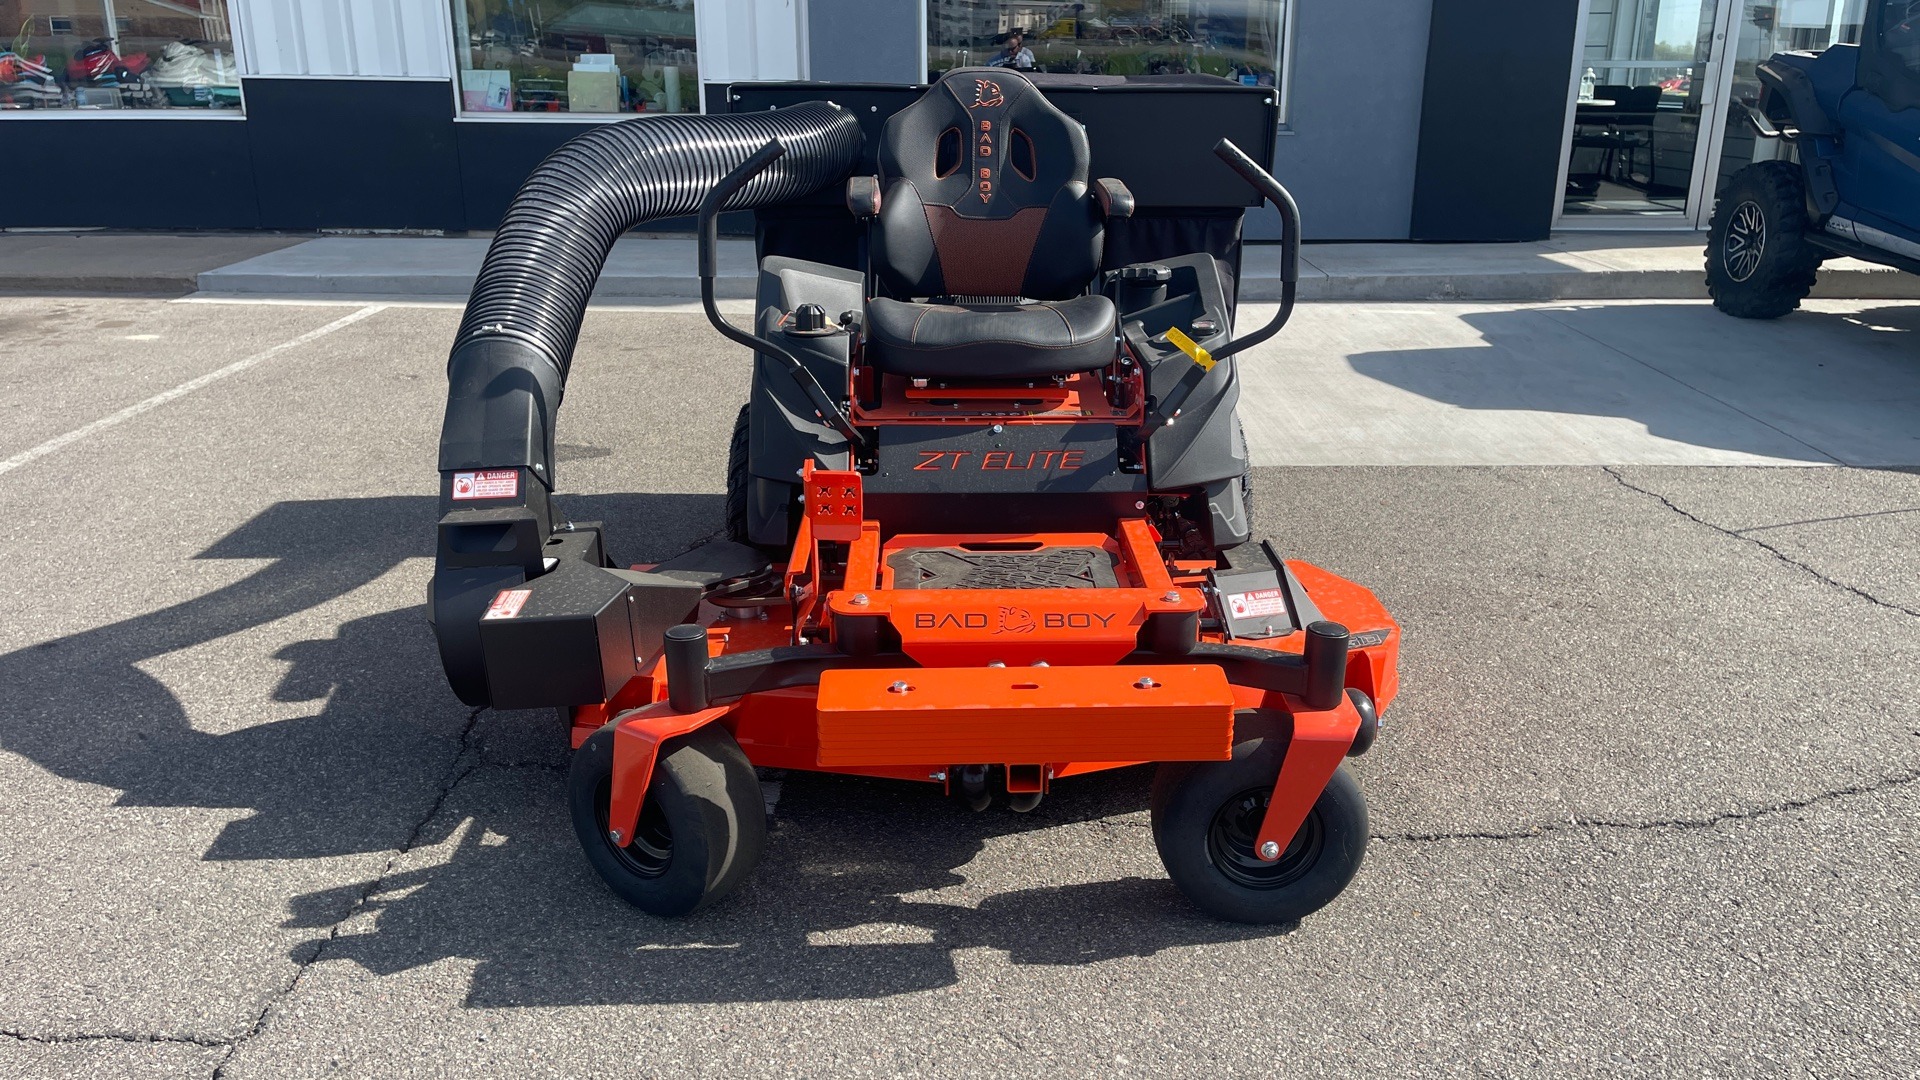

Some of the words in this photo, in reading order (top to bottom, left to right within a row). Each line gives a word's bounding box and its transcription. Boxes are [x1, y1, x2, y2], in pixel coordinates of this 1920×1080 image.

[979, 120, 992, 157] BAD
[979, 167, 992, 204] BOY
[913, 450, 972, 471] ZT
[981, 450, 1085, 471] ELITE
[486, 471, 515, 480] DANGER
[1254, 590, 1279, 599] DANGER
[915, 613, 988, 629] BAD
[1044, 613, 1116, 629] BOY
